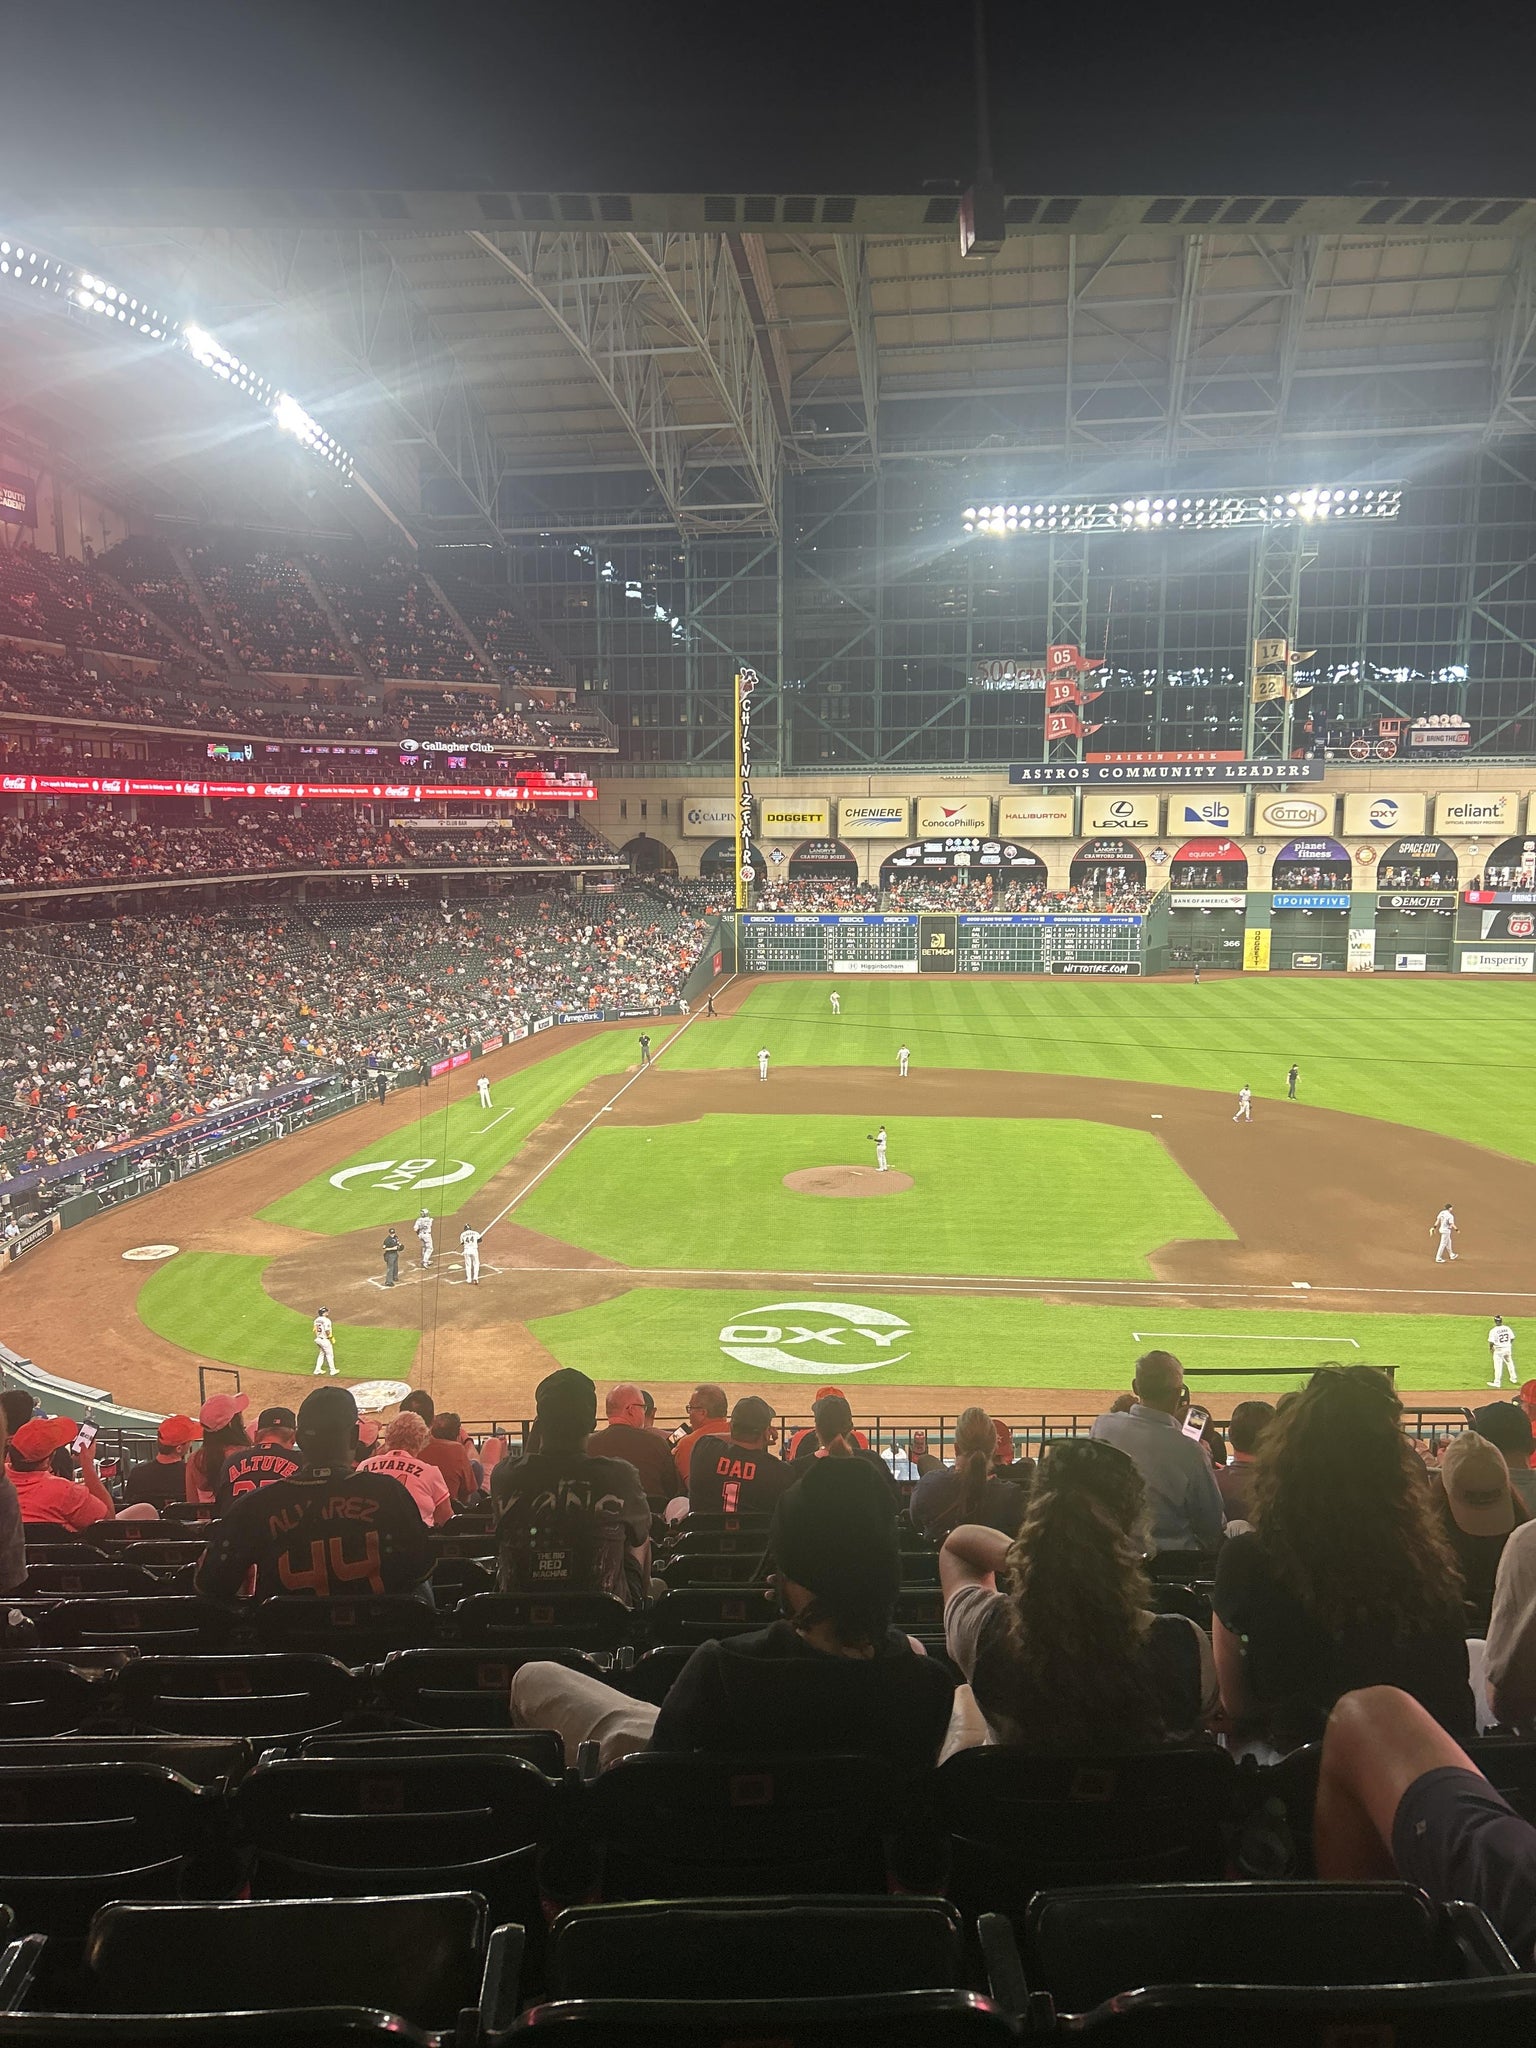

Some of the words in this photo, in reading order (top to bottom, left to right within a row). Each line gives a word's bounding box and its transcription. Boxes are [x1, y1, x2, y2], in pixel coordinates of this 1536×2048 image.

[1054, 650, 1071, 664] 05
[1262, 645, 1278, 658] 17
[1054, 686, 1070, 699] 19
[1260, 682, 1276, 694] 22
[1052, 718, 1067, 730] 21
[740, 698, 751, 778] CHIKIN
[422, 741, 469, 753] Gallagher
[470, 742, 494, 752] Club
[1022, 768, 1090, 779] ASTROS
[1099, 766, 1216, 778] COMMUNITY
[1226, 766, 1310, 776] LEADERS
[845, 808, 902, 817] CHENIERE
[1202, 802, 1229, 817] slb
[1272, 807, 1317, 822] COTTON
[1448, 804, 1500, 817] reliant
[922, 819, 985, 828] ConocoPhillips
[741, 812, 752, 865] FAIR
[1294, 842, 1326, 851] planet
[1298, 849, 1332, 858] fitness
[1277, 897, 1346, 906] 1POINTFIVE
[1402, 898, 1443, 907] EMCJET
[1512, 922, 1528, 931] 66
[1480, 955, 1528, 966] Insperity
[1064, 964, 1128, 974] NITTOTIRE.COM
[564, 1012, 599, 1023] AmegyBank
[371, 1158, 437, 1190] OXY
[718, 1325, 914, 1347] OXY
[1499, 1334, 1509, 1343] 23
[229, 1455, 299, 1482] ALTUVE
[363, 1460, 423, 1477] ALVAREZ
[717, 1456, 757, 1481] DAD
[722, 1481, 742, 1513] 1
[269, 1496, 380, 1536] ALVREZ
[278, 1530, 385, 1596] 44
[539, 1560, 562, 1570] RED
[533, 1569, 568, 1578] MACHINE
